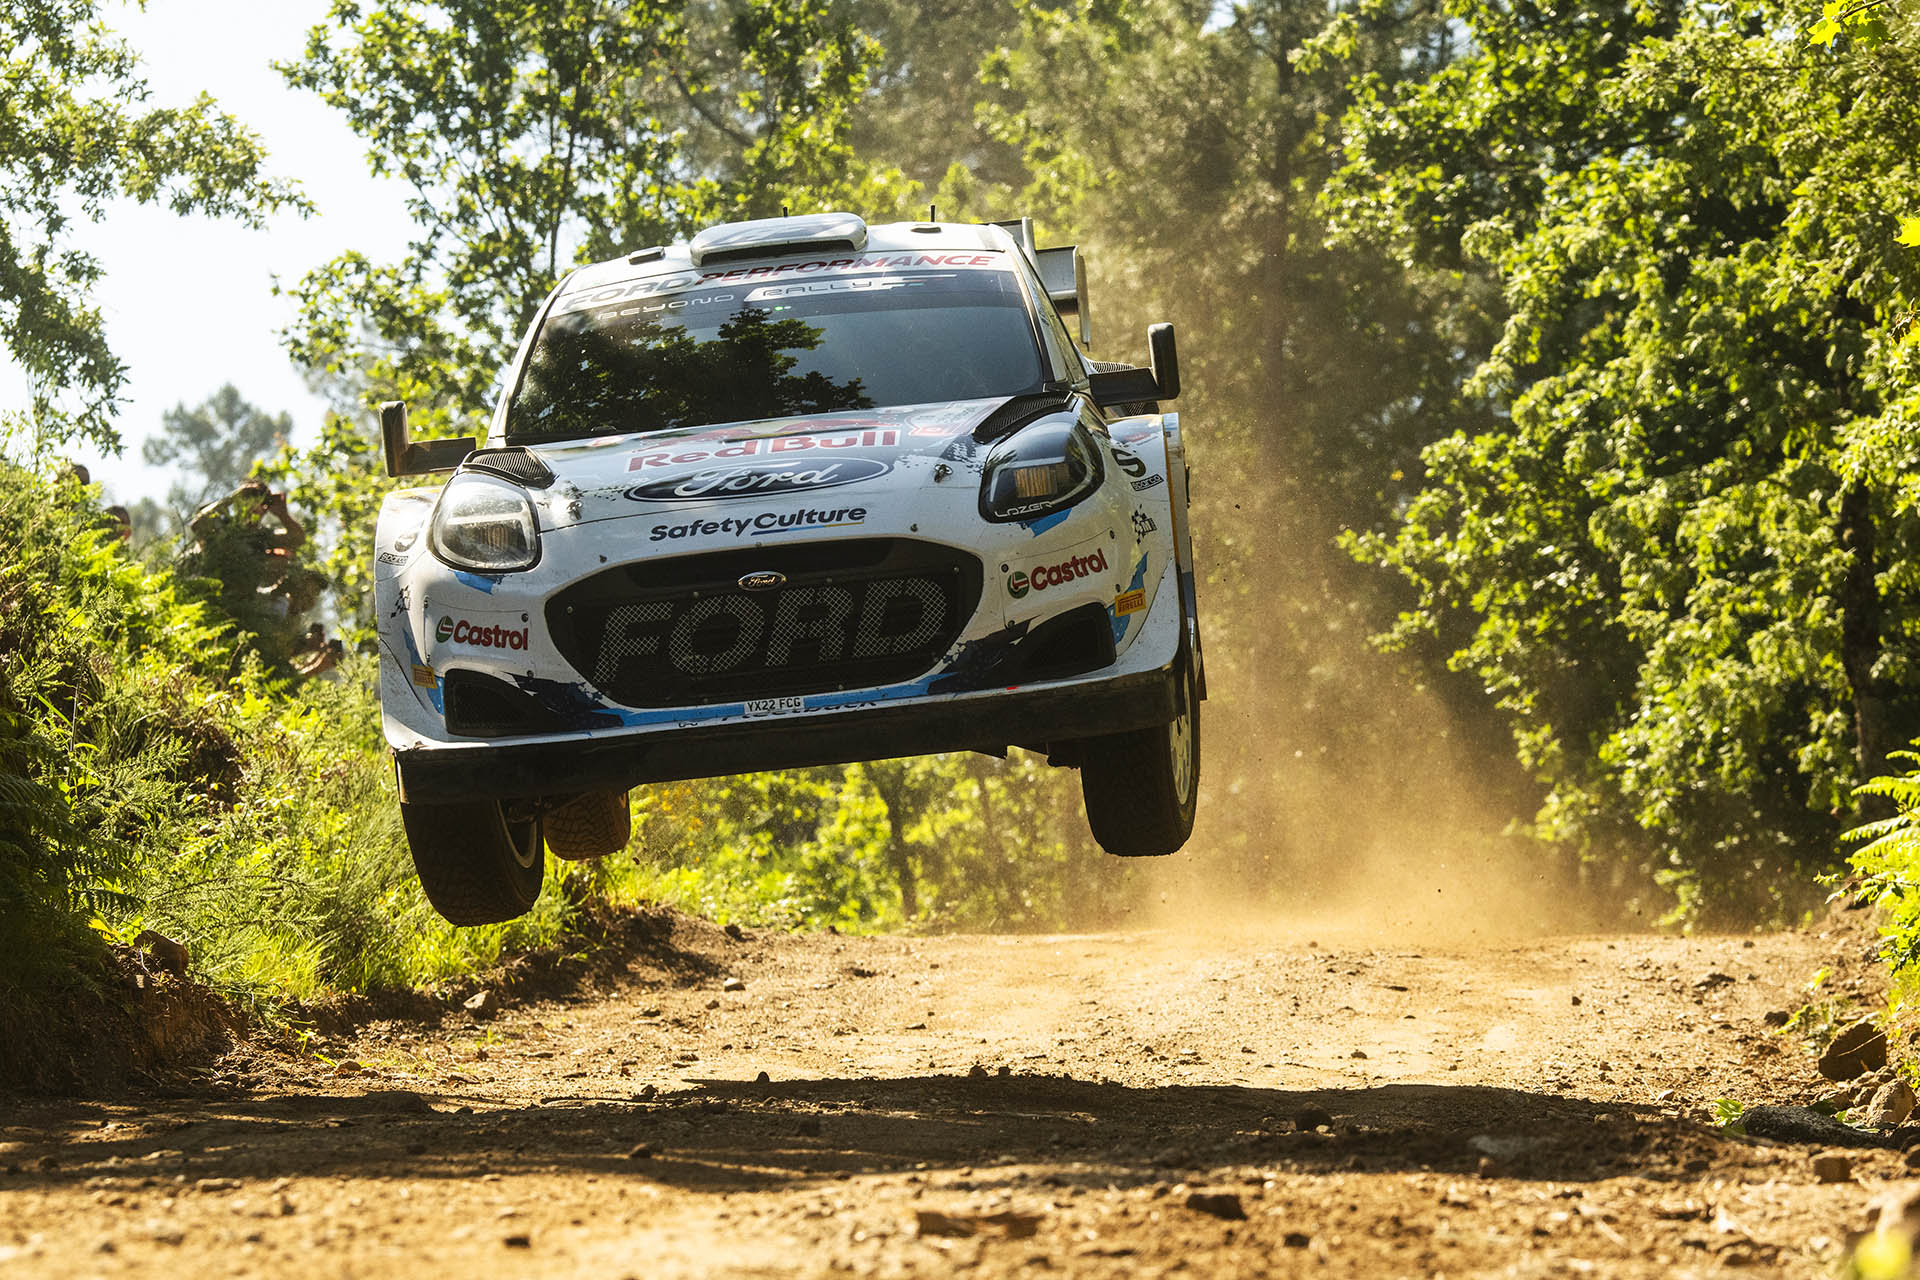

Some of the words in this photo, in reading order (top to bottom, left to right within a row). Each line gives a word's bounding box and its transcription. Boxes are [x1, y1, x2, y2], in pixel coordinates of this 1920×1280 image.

[561, 276, 697, 311] FORD
[695, 255, 994, 286] PERFORMANCE
[598, 294, 734, 320] BEYOND
[763, 281, 872, 297] RALLY
[627, 440, 758, 473] Red
[771, 430, 896, 453] Bull
[674, 461, 842, 497] Ford
[650, 507, 867, 541] SafetyCulture
[994, 501, 1052, 518] LAZER
[747, 574, 776, 588] Ford
[1031, 548, 1108, 591] Castrol
[1118, 593, 1143, 613] PIRELLI
[453, 620, 528, 650] Castrol
[592, 577, 947, 683] FORD
[747, 699, 776, 713] YX22
[779, 697, 801, 709] FCG
